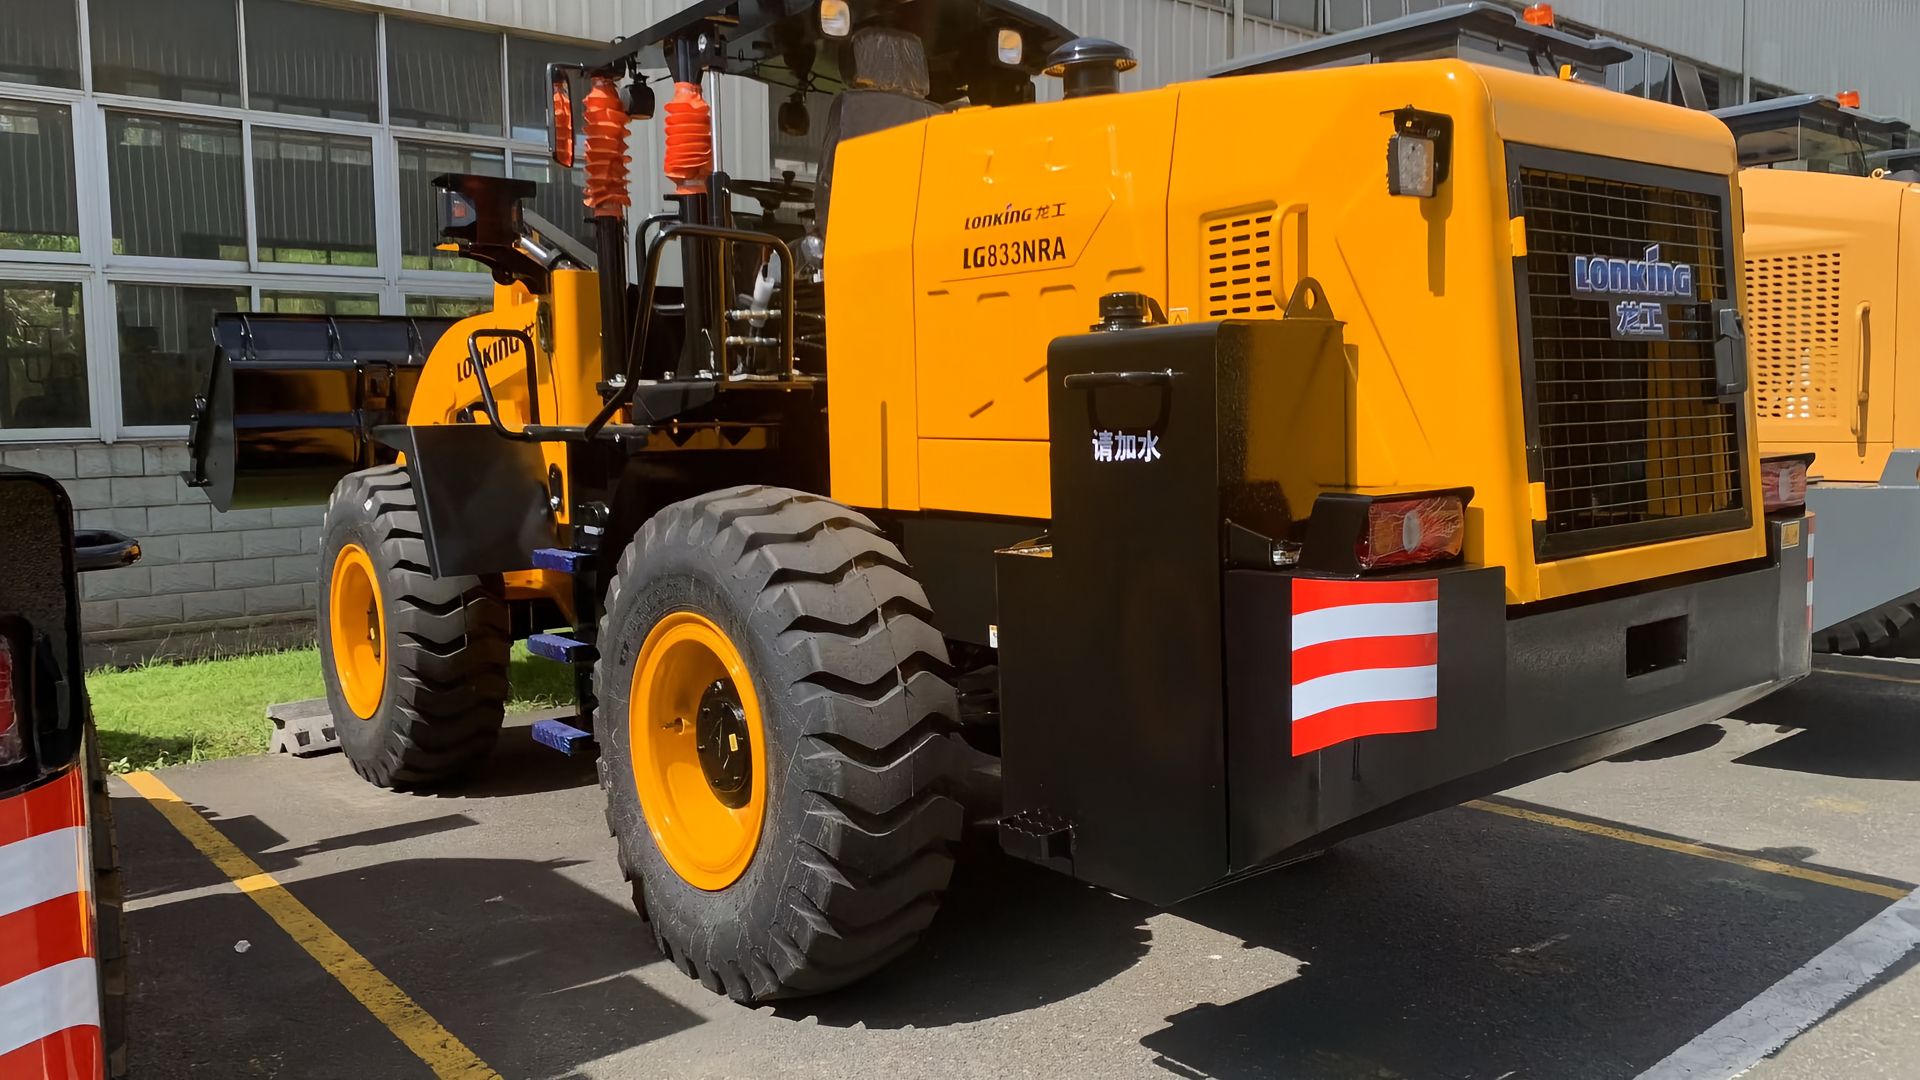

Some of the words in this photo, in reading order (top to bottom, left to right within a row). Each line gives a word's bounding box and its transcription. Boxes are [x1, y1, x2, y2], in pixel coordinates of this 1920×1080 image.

[1035, 202, 1067, 220] 龙工
[963, 236, 1066, 269] LG833NRA
[1616, 300, 1664, 335] 龙工
[1092, 429, 1161, 463] 请加水
